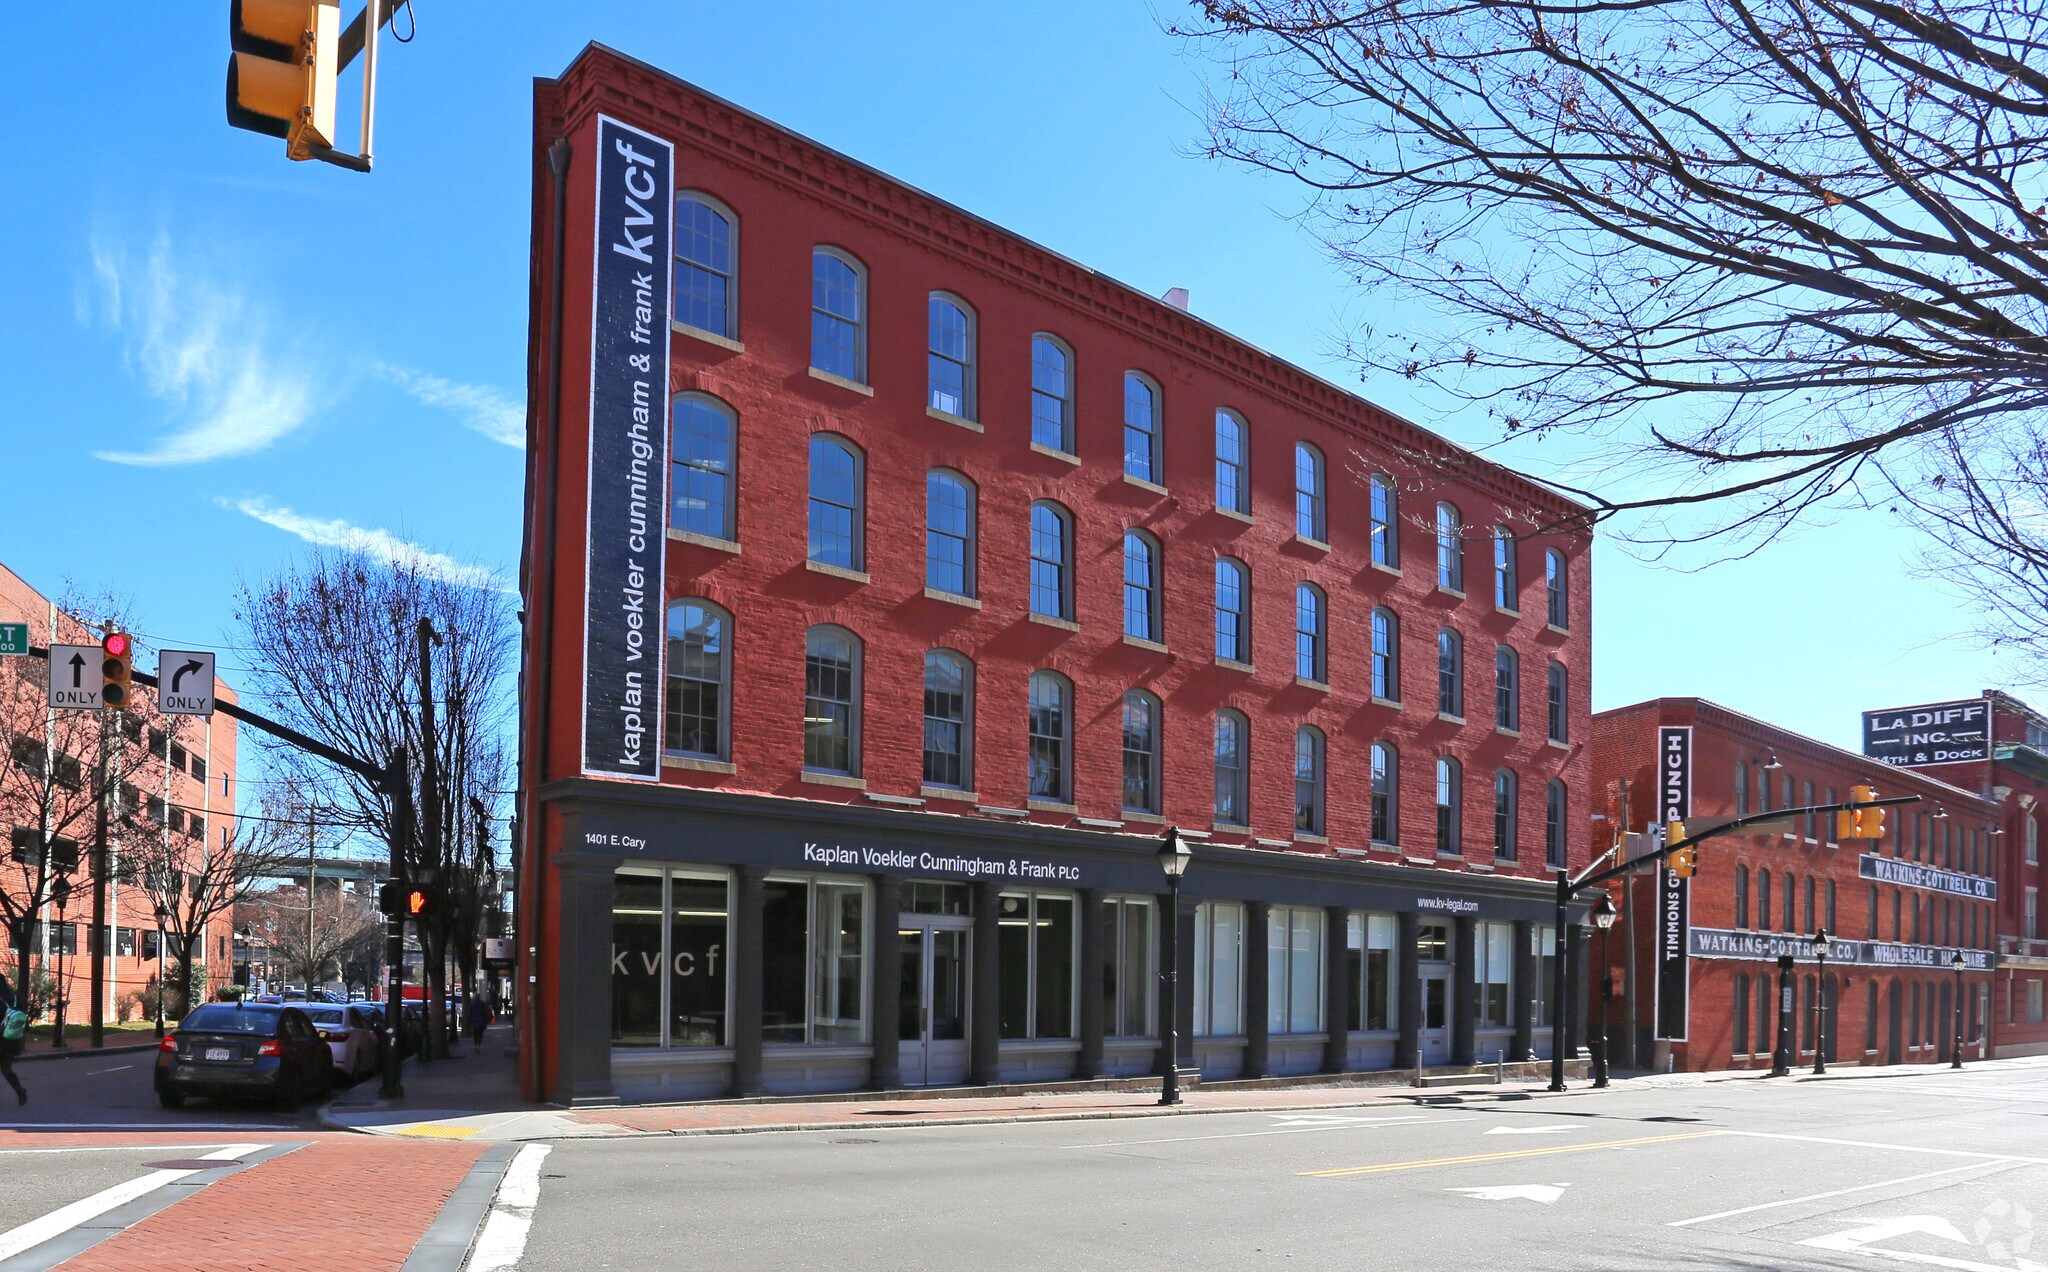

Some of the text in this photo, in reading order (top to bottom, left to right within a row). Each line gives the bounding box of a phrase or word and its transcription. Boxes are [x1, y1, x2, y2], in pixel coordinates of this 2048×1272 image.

[613, 138, 656, 766] kaplan voekler cunningham & frank kvcf
[55, 691, 98, 704] ONLY
[166, 696, 207, 710] ONLY
[1911, 706, 1984, 728] DIFF
[1914, 750, 1928, 762] &
[1668, 735, 1683, 822] PUNCH
[585, 833, 646, 849] 1401 E. Cary
[804, 843, 1080, 880] Kaplan Voekler Cunningham & Frank PLC
[1875, 860, 1972, 894] WATKINS-COTTRELL
[1417, 896, 1479, 913] www.kv-legal.com
[1667, 891, 1680, 961] TIMMONS
[1836, 943, 1855, 960] CO.
[1873, 945, 1934, 965] WHOLESALE
